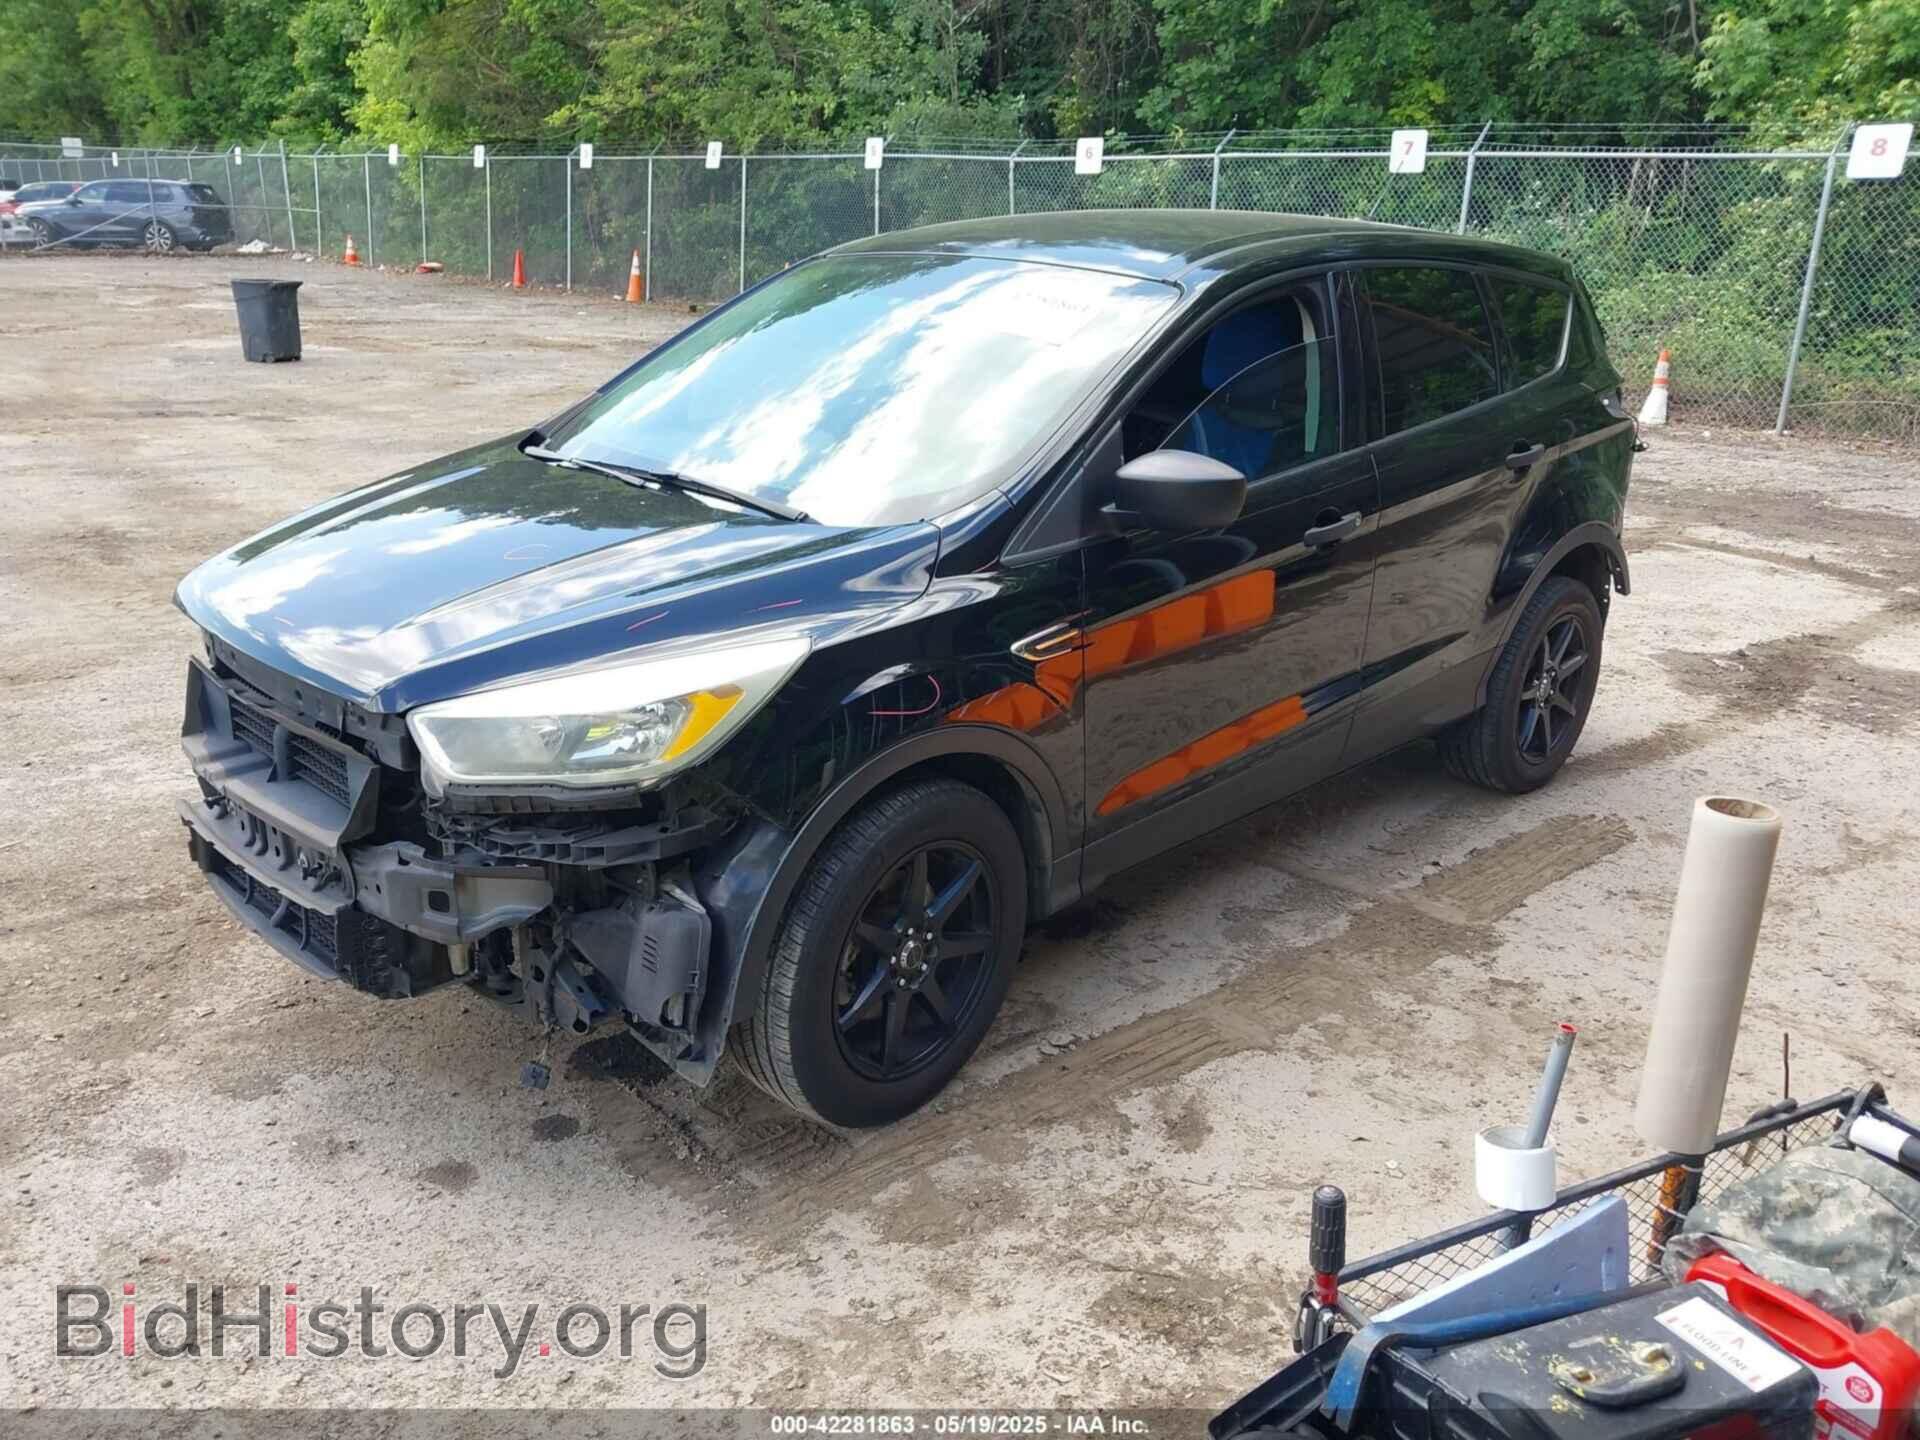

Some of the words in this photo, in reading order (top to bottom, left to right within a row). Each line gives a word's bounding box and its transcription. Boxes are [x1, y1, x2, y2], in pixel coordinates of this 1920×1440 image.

[1085, 146, 1094, 160] 6
[1404, 140, 1415, 156] 7
[1870, 139, 1888, 156] 8
